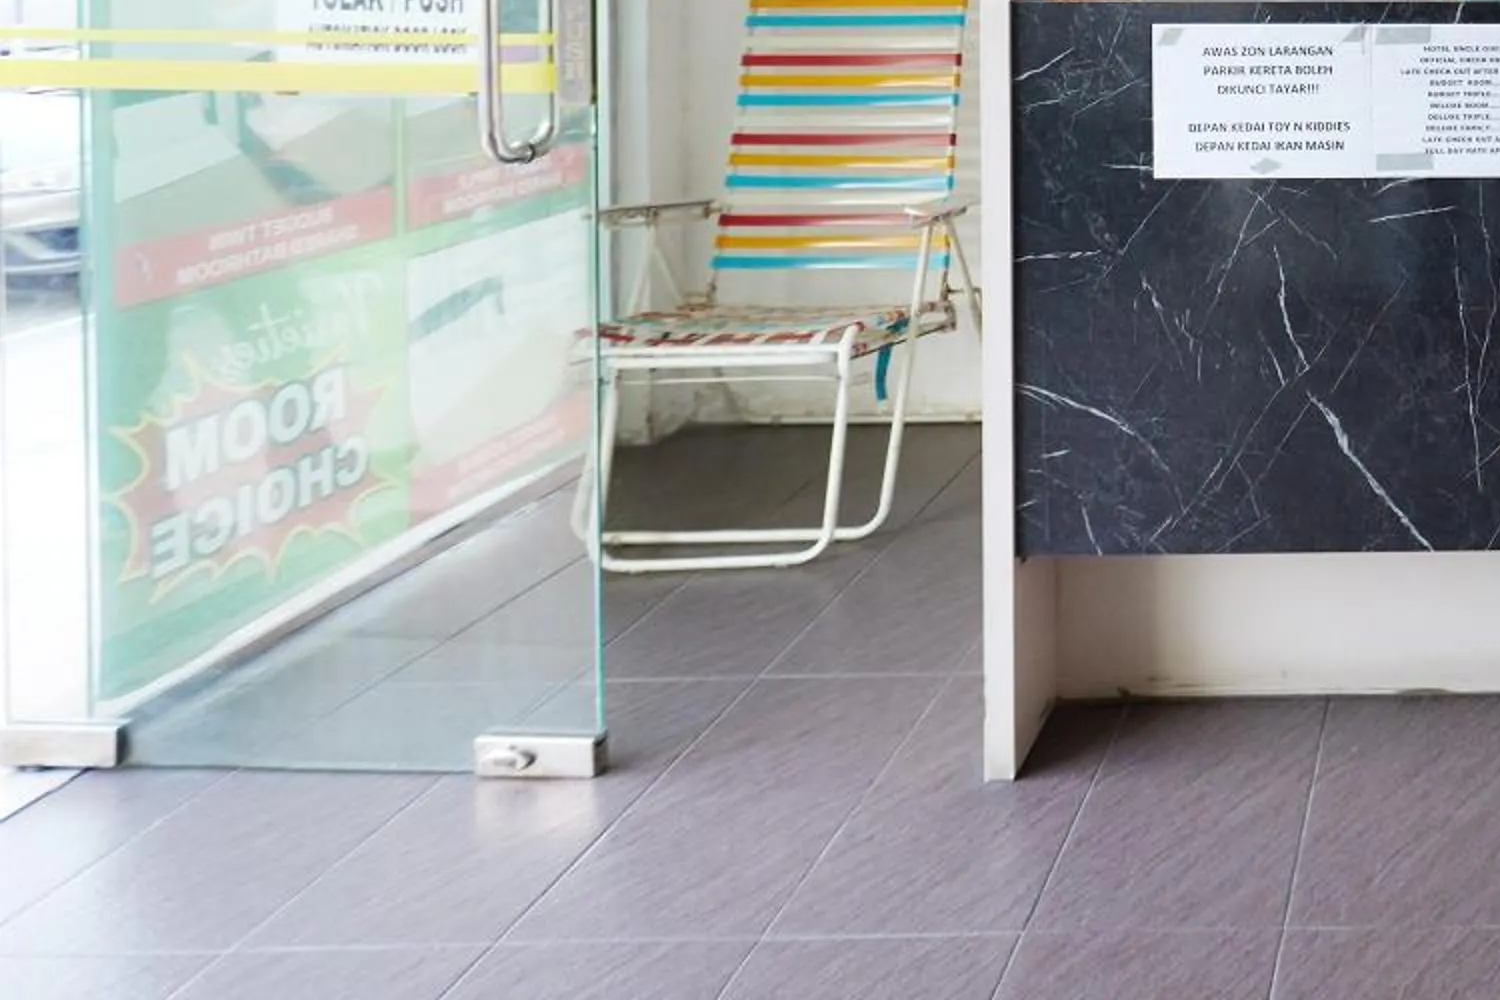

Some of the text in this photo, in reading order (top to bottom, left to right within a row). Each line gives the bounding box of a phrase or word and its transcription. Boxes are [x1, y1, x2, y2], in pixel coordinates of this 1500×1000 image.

[1202, 46, 1333, 56] AWAS ZON LARANGAN
[1203, 65, 1333, 75] PARKIR KERETA BOLEH
[1217, 84, 1319, 95] DIKUNCI TAYAR!!!
[1188, 121, 1351, 133] DEPAN KEDAI TOY N KIDDIES
[1195, 141, 1345, 152] DEPAN KEDAI IKAN MASIN
